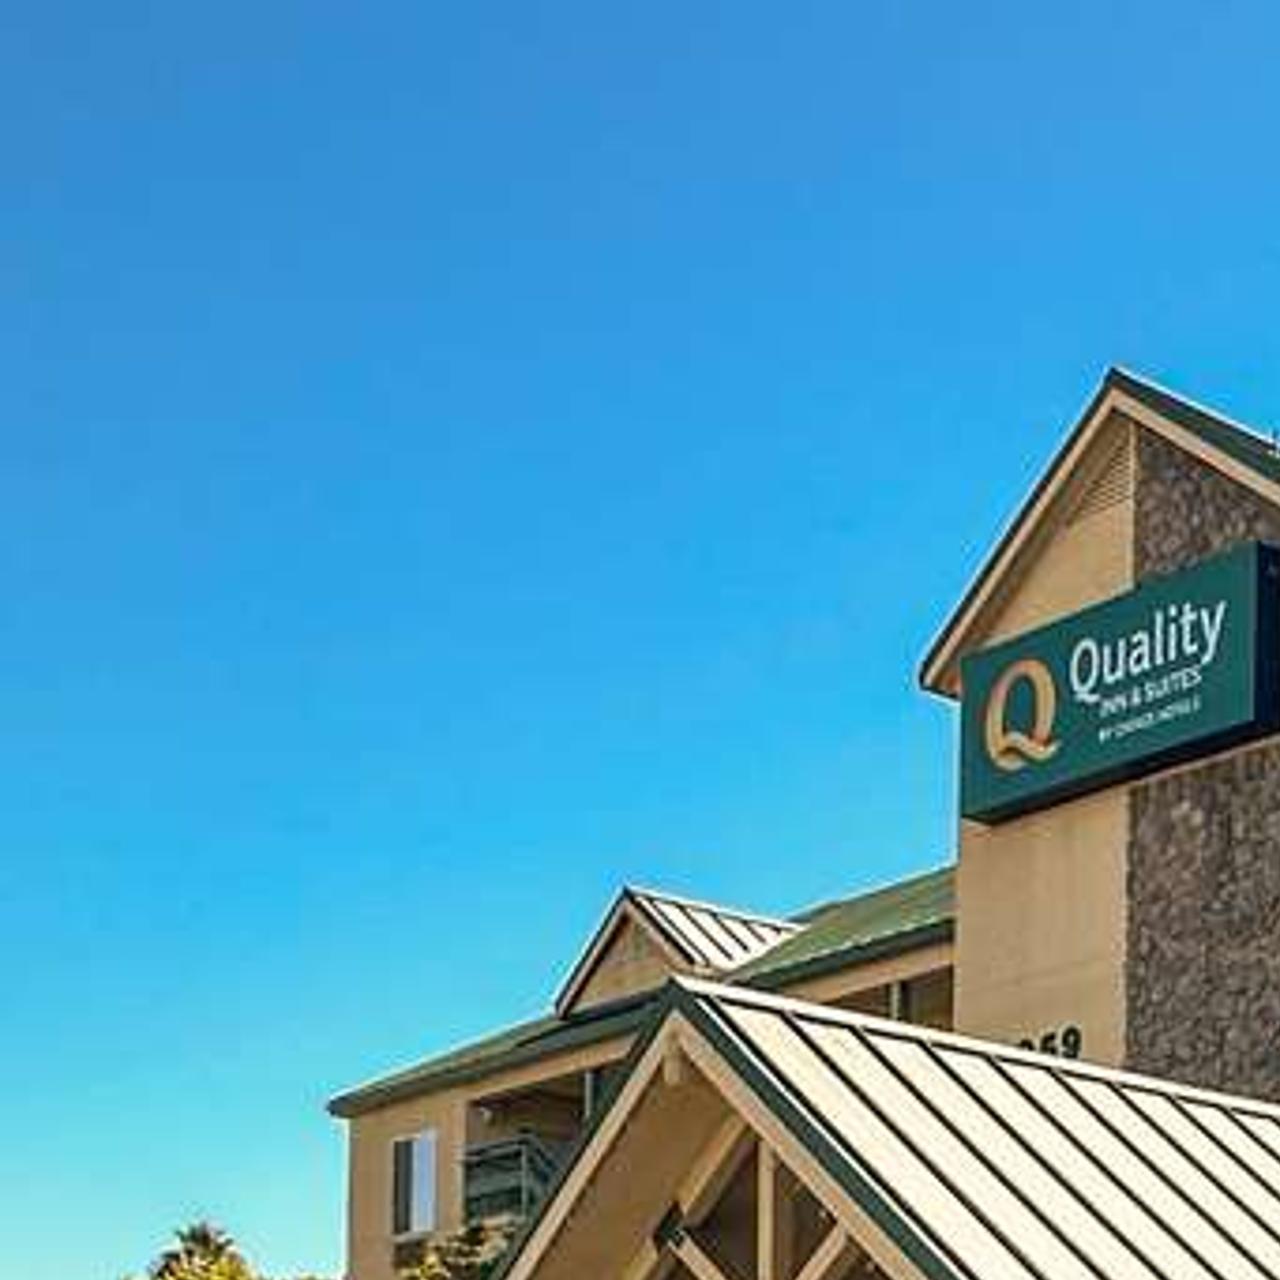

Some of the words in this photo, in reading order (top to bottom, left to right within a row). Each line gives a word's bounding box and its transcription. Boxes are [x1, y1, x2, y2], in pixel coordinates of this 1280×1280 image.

[1069, 600, 1227, 702] Quality
[1099, 694, 1128, 717] INN
[1143, 664, 1202, 702] SUITES
[985, 658, 1062, 770] Q
